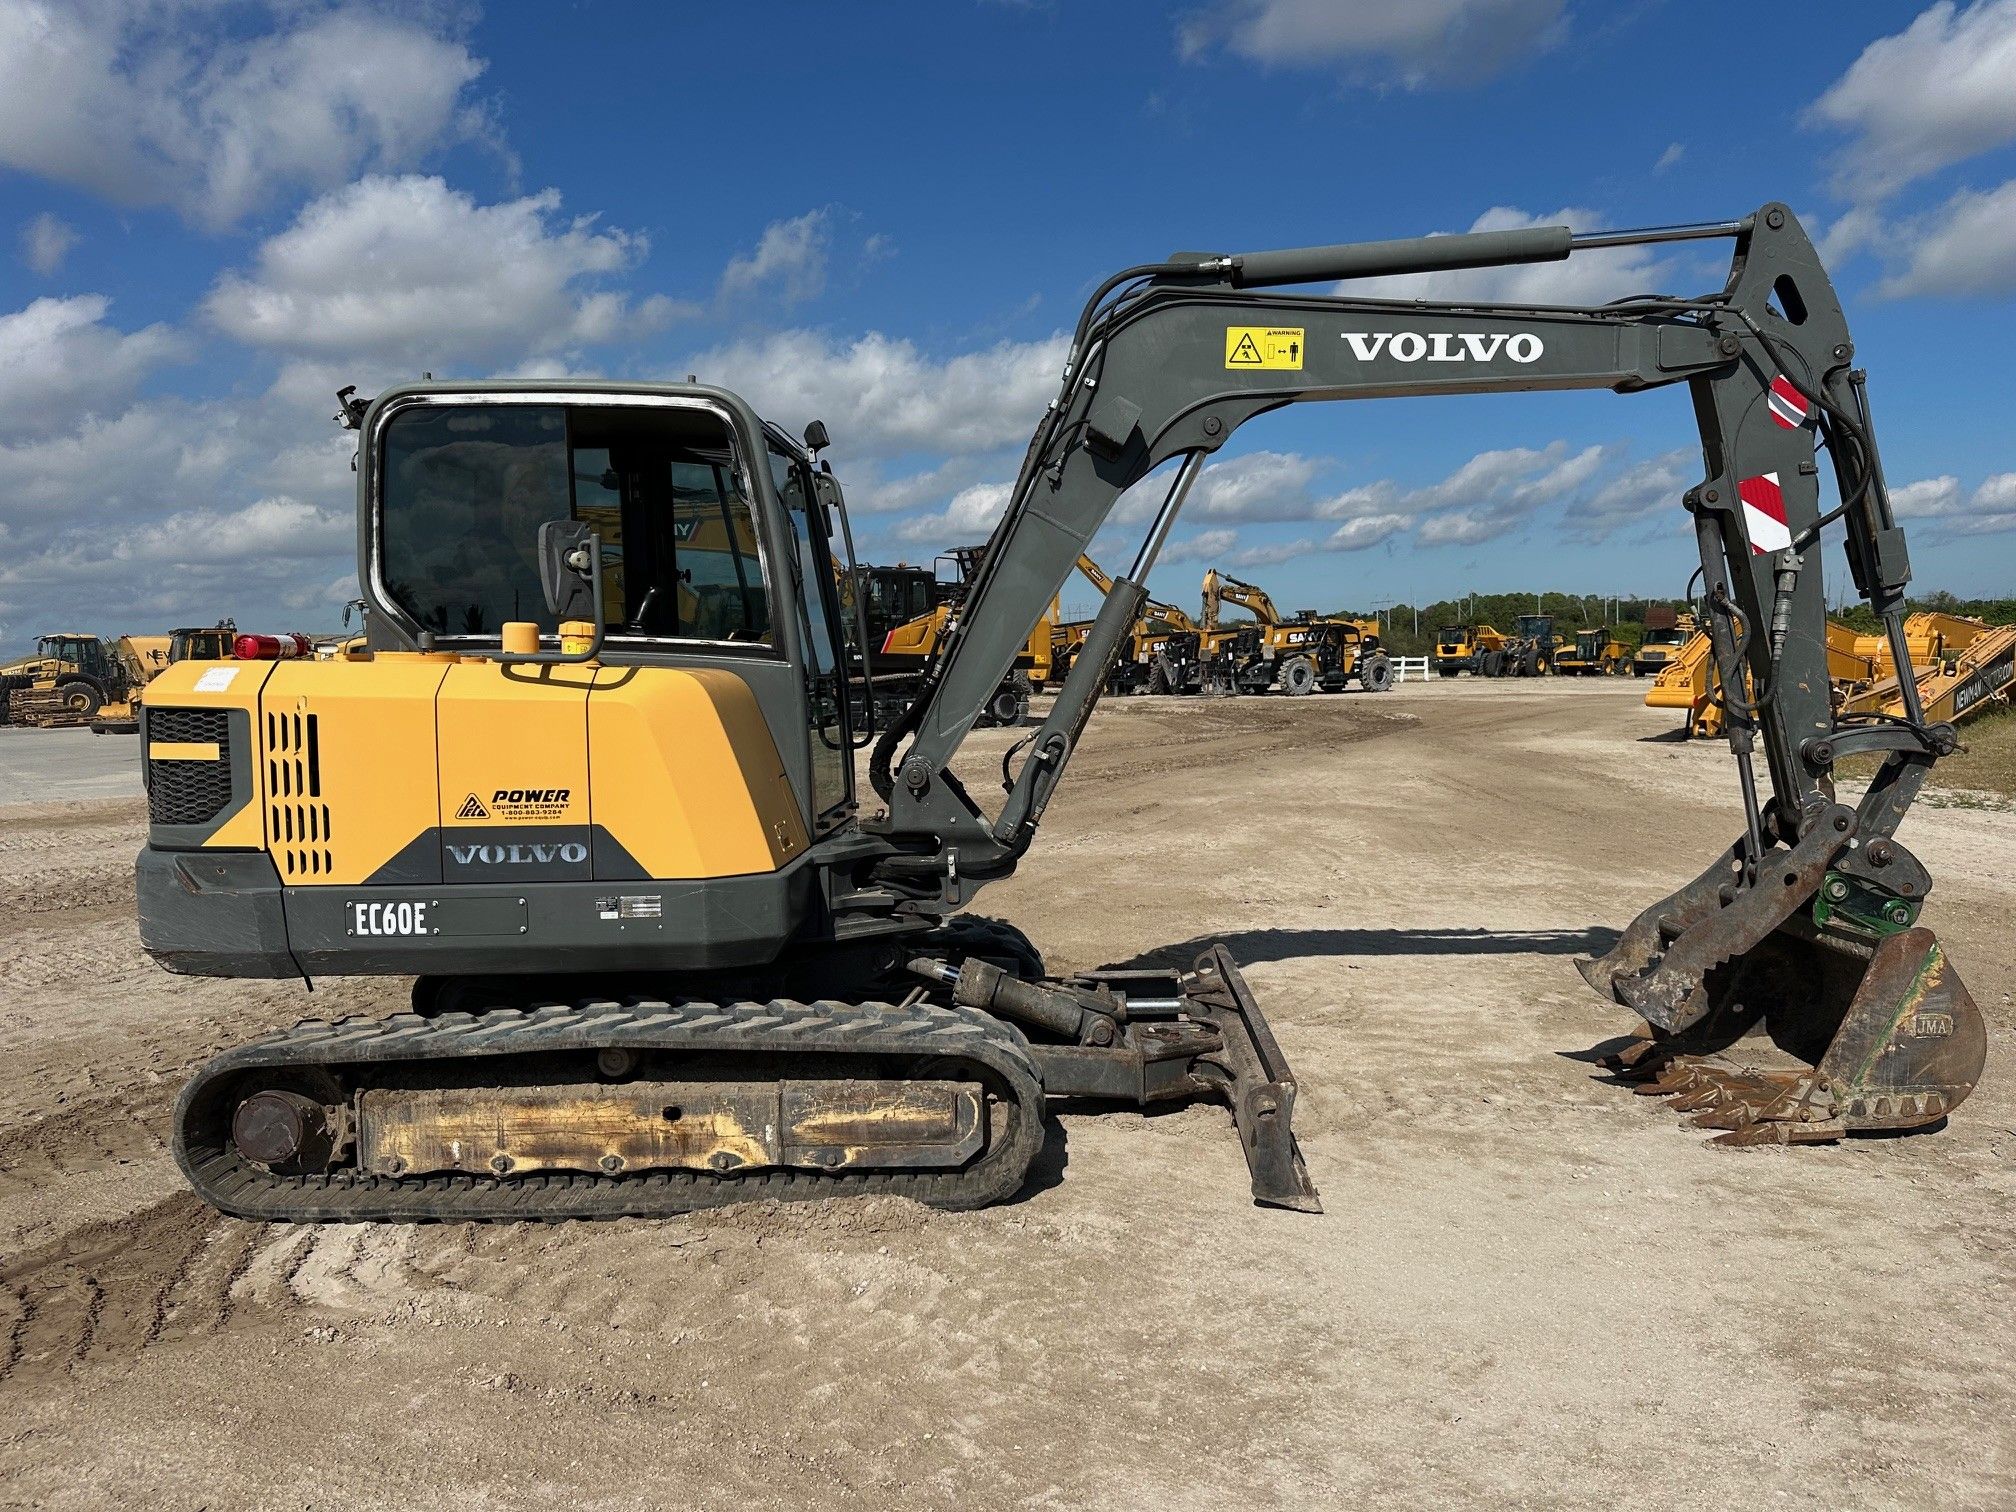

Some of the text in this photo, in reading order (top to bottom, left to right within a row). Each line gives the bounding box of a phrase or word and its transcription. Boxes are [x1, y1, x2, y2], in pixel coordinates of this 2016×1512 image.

[1340, 332, 1544, 363] VOLVO
[491, 789, 571, 804] POWER
[446, 842, 588, 864] VOLVO
[355, 902, 428, 935] EC60E
[1917, 1020, 1947, 1034] JMA
